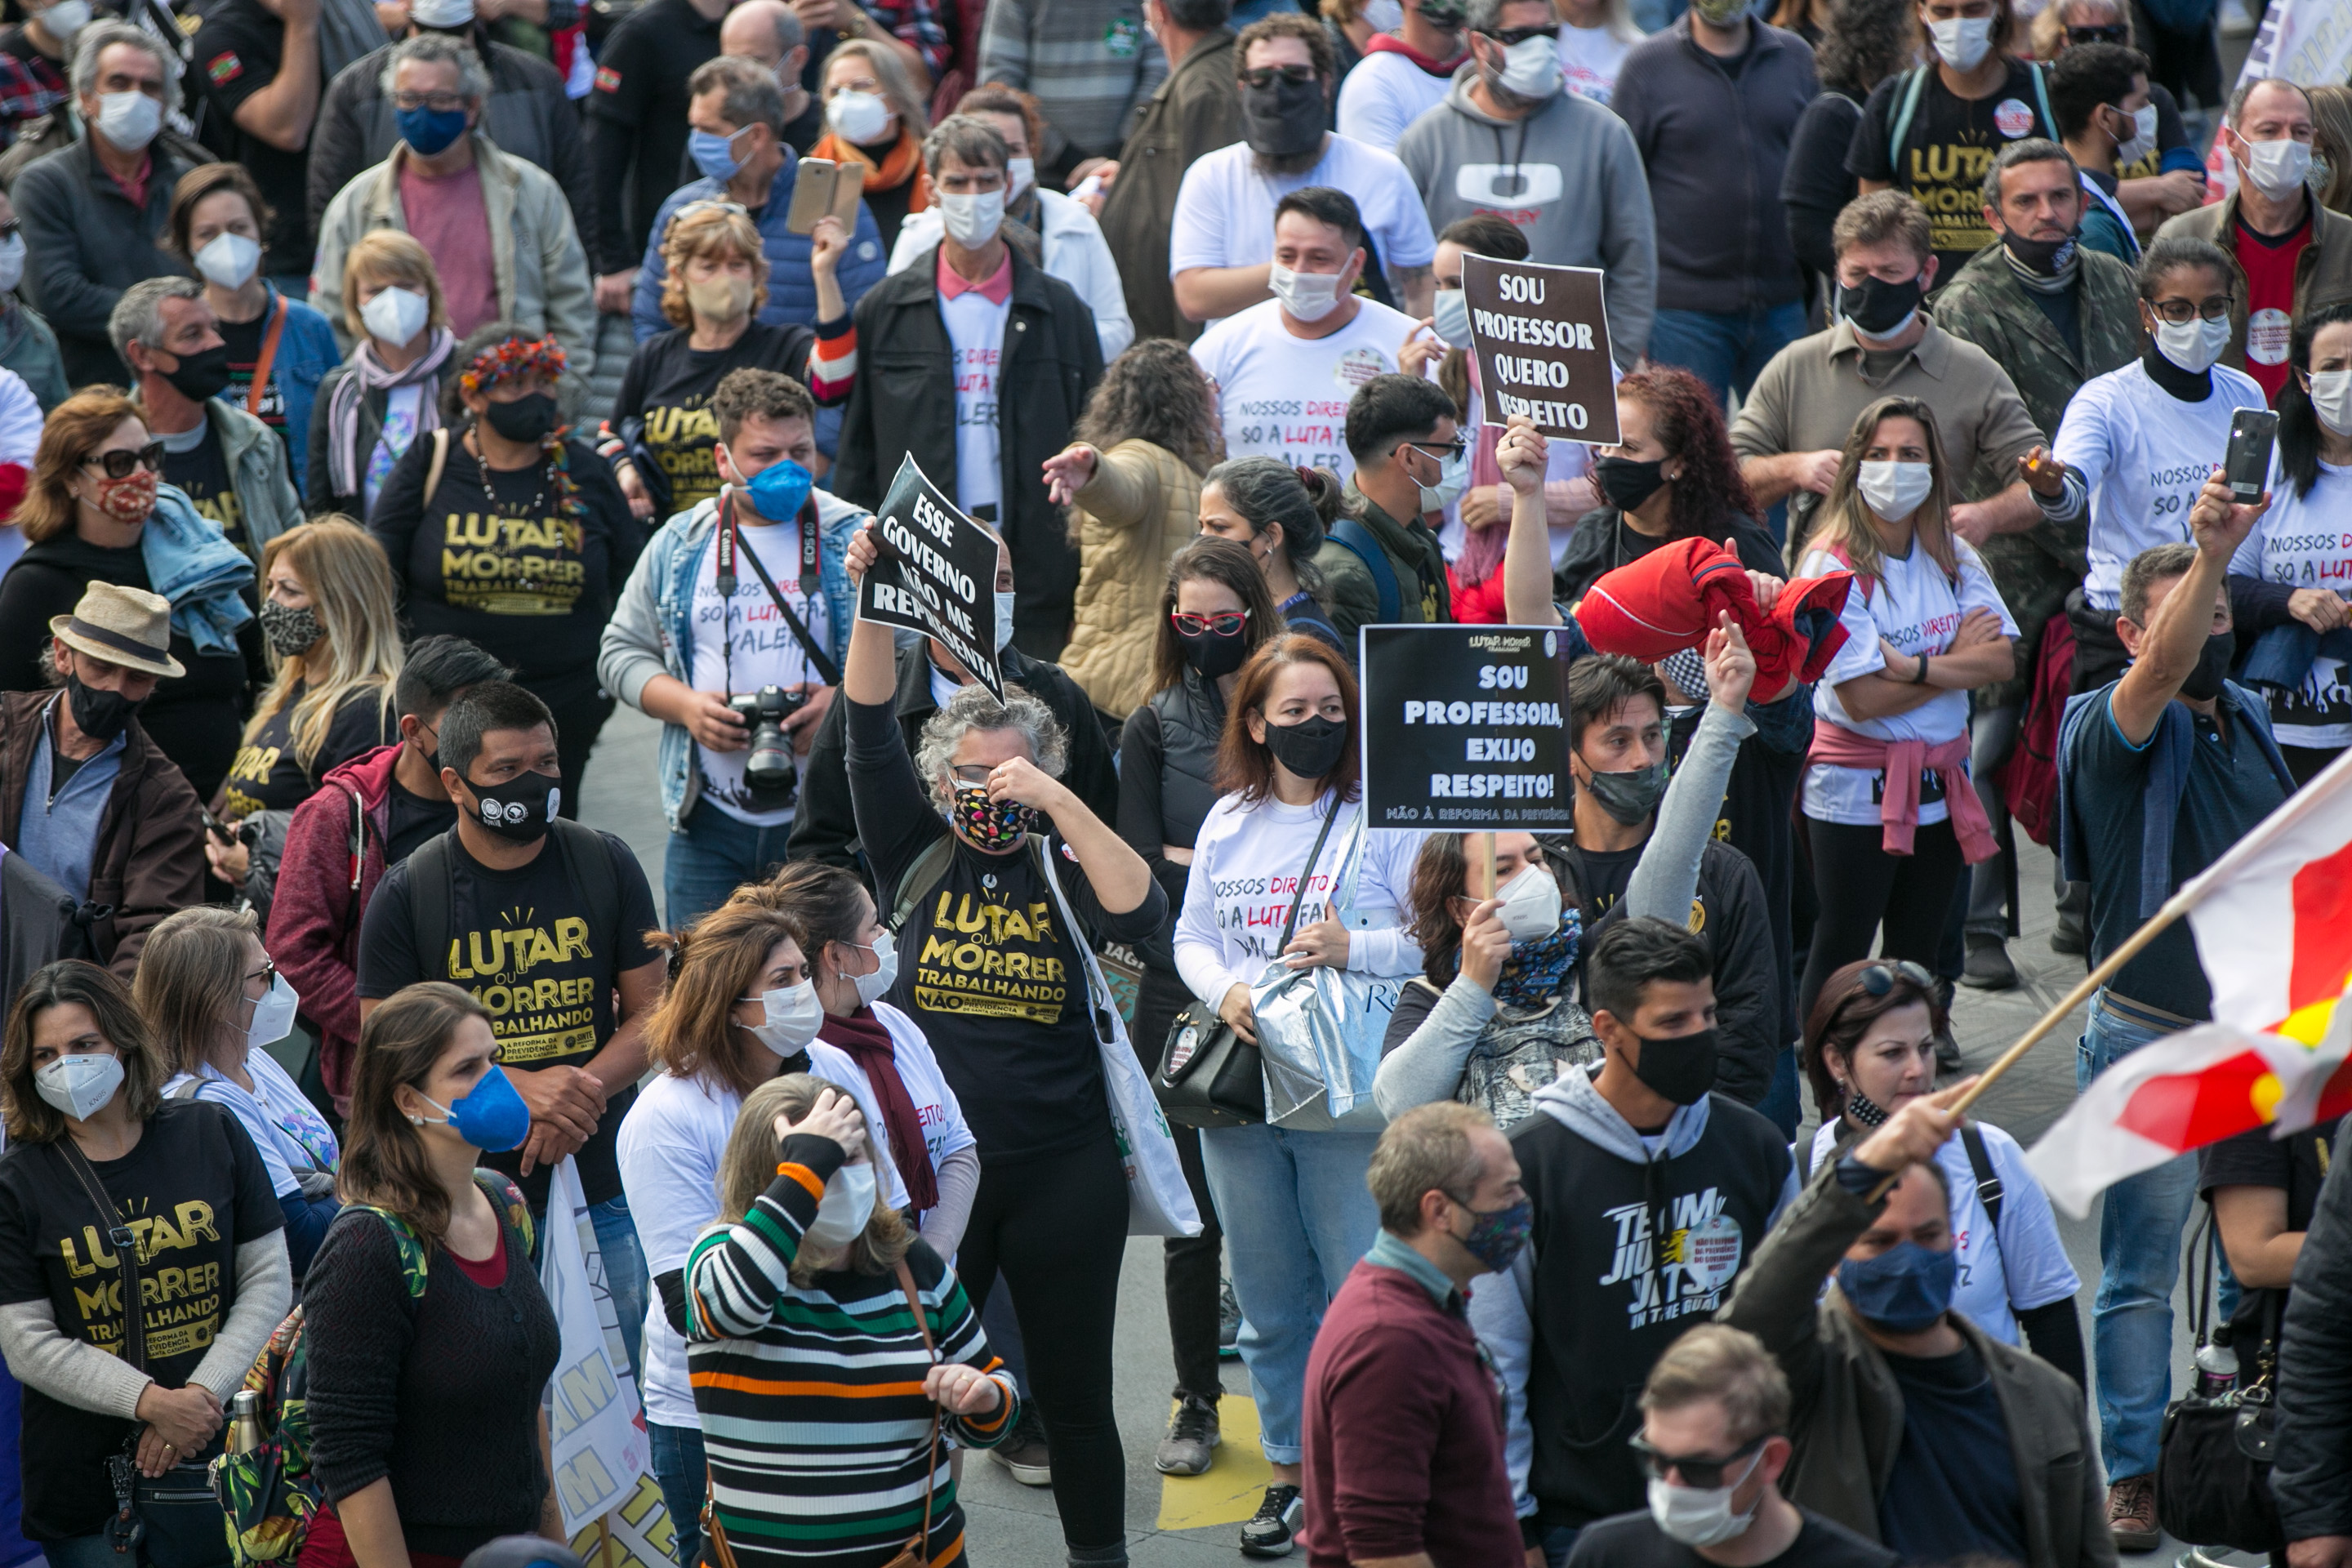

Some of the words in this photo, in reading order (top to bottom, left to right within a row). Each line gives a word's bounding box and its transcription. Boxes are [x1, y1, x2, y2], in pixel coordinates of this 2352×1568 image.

[1910, 143, 2001, 184] LUTA
[1911, 185, 1985, 213] MOR
[1499, 273, 1545, 305] SOU
[1473, 308, 1595, 350] PROFESSOR
[955, 373, 990, 395] UTA
[1494, 353, 1570, 389] QUERO
[1239, 400, 1303, 417] NOSSOS
[1496, 390, 1588, 430] RESPEITO
[644, 406, 721, 444] LUTA
[1268, 424, 1281, 446] A
[1285, 425, 1333, 447] LUTA
[2151, 464, 2210, 487] NOSSOS
[2154, 488, 2180, 516] SÓ
[445, 512, 578, 550] LUTAR
[912, 492, 955, 547] ESSE
[721, 528, 733, 567] Canon
[804, 537, 816, 565] EOS
[2271, 534, 2336, 553] NOSSOS
[442, 548, 586, 583] MORRER
[883, 514, 976, 604] GOVERNO
[2274, 555, 2295, 581] SÓ
[2302, 560, 2315, 582] A
[2320, 559, 2352, 579] LUT
[699, 582, 761, 598] NOSOS
[898, 559, 940, 611] NÃO
[945, 598, 976, 640] ME
[873, 582, 999, 691] REPRESENTA
[1922, 612, 1961, 638] DIREITO
[1469, 635, 1501, 648] LUTAR
[1477, 665, 1529, 690] SOU
[1404, 700, 1564, 728] PROFESSORA,
[1466, 737, 1536, 763] EXIJO
[1430, 773, 1554, 799] RESPEITO!
[1386, 805, 1419, 820] NÃO
[1439, 808, 1501, 821] REFORMA
[1503, 808, 1519, 821] DA
[1214, 878, 1266, 898] OSSOS
[933, 890, 1058, 946] LUTAR
[1232, 906, 1244, 931] A
[1299, 902, 1321, 924] FA
[449, 917, 593, 979] LUTAR
[970, 933, 993, 946] OU
[920, 934, 1067, 982] MORRER
[495, 971, 516, 985] OU
[917, 968, 1067, 1001] TRABALHANDO
[917, 990, 963, 1010] NÃO
[492, 1007, 594, 1036] BALHANDO
[506, 1043, 558, 1055] PREVIDÊNCIA
[513, 1039, 547, 1048] REFORMA
[577, 1031, 594, 1041] SINTE
[514, 1052, 532, 1060] SANTA
[533, 1049, 559, 1058] CATARINA
[87, 1089, 108, 1108] KN95
[60, 1200, 220, 1279] LUTAR
[87, 1294, 220, 1341] TRALHANDO
[148, 1338, 189, 1352] EVIDÊNCIA
[179, 1330, 188, 1338] DA
[167, 1344, 191, 1353] CATARINA
